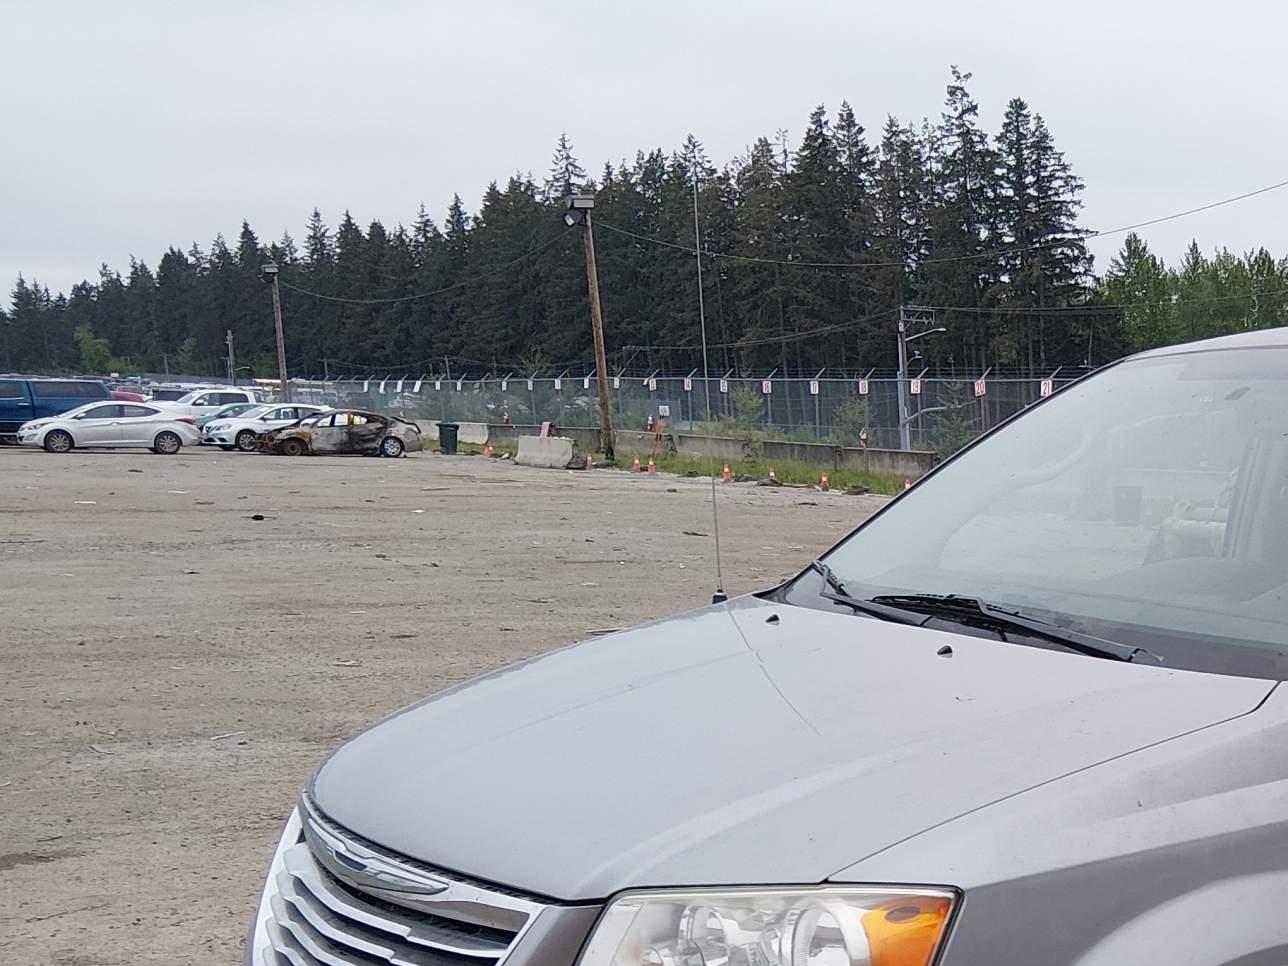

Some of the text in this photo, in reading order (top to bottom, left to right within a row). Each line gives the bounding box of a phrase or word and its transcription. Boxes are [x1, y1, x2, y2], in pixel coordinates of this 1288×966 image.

[912, 380, 919, 393] 19
[976, 381, 984, 394] 20
[1043, 382, 1051, 395] 21
